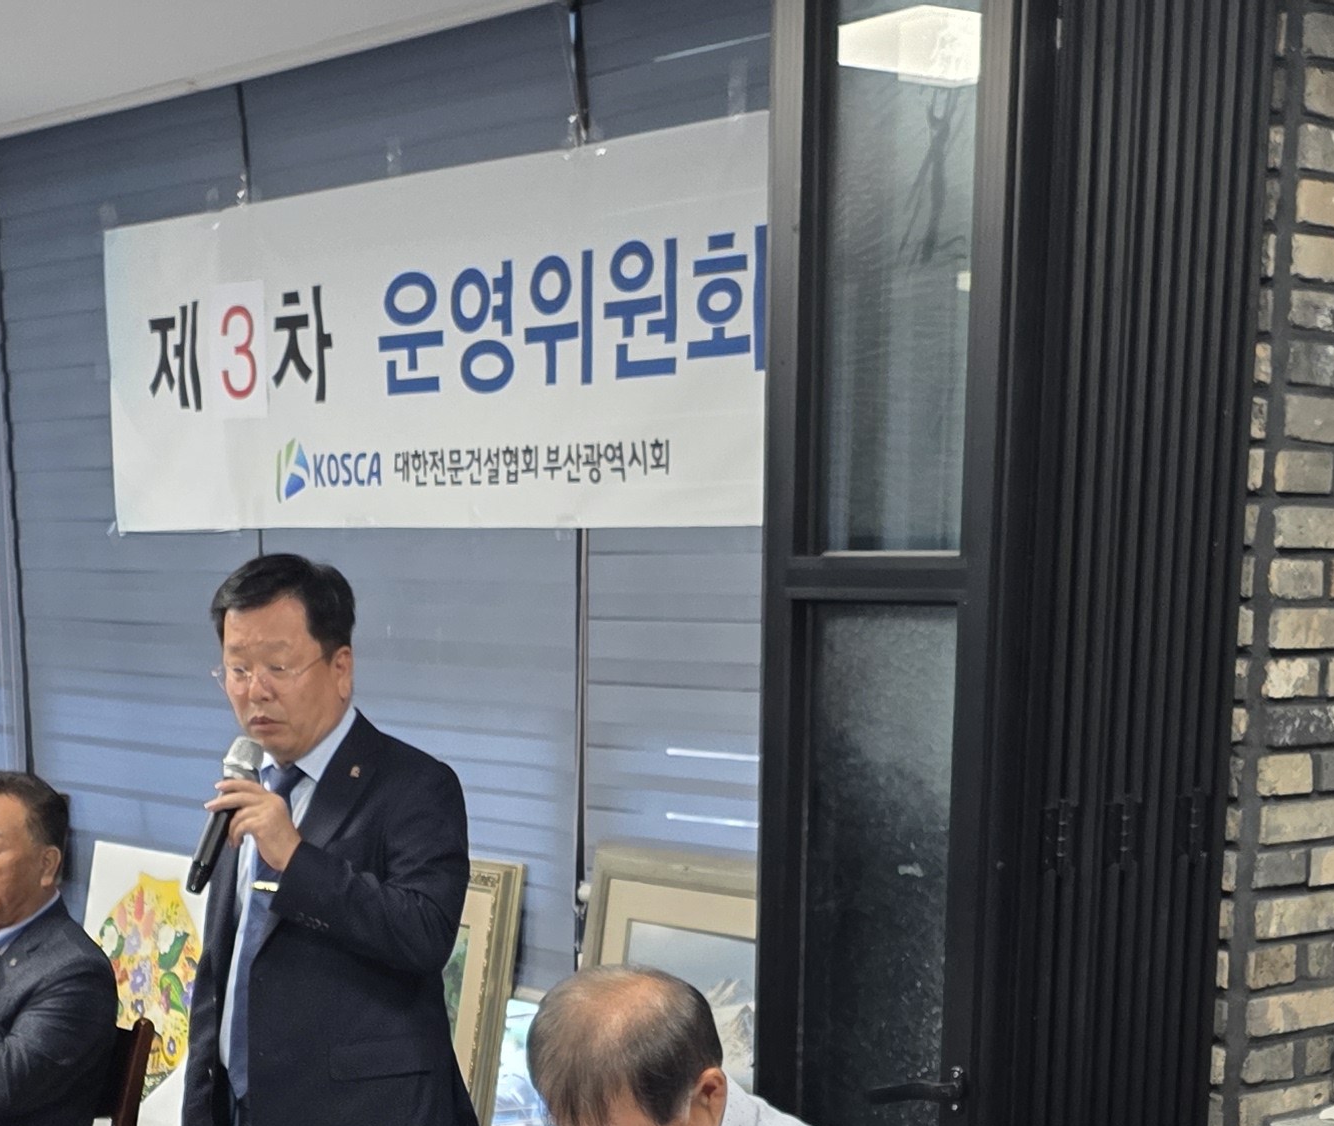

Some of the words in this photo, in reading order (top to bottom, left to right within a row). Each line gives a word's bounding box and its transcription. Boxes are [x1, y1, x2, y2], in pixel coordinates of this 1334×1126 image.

[377, 224, 767, 396] 운영위원회
[313, 452, 382, 488] KOSCA
[393, 446, 539, 487] 대한전문건설협회
[542, 438, 670, 484] 부산광역시회
